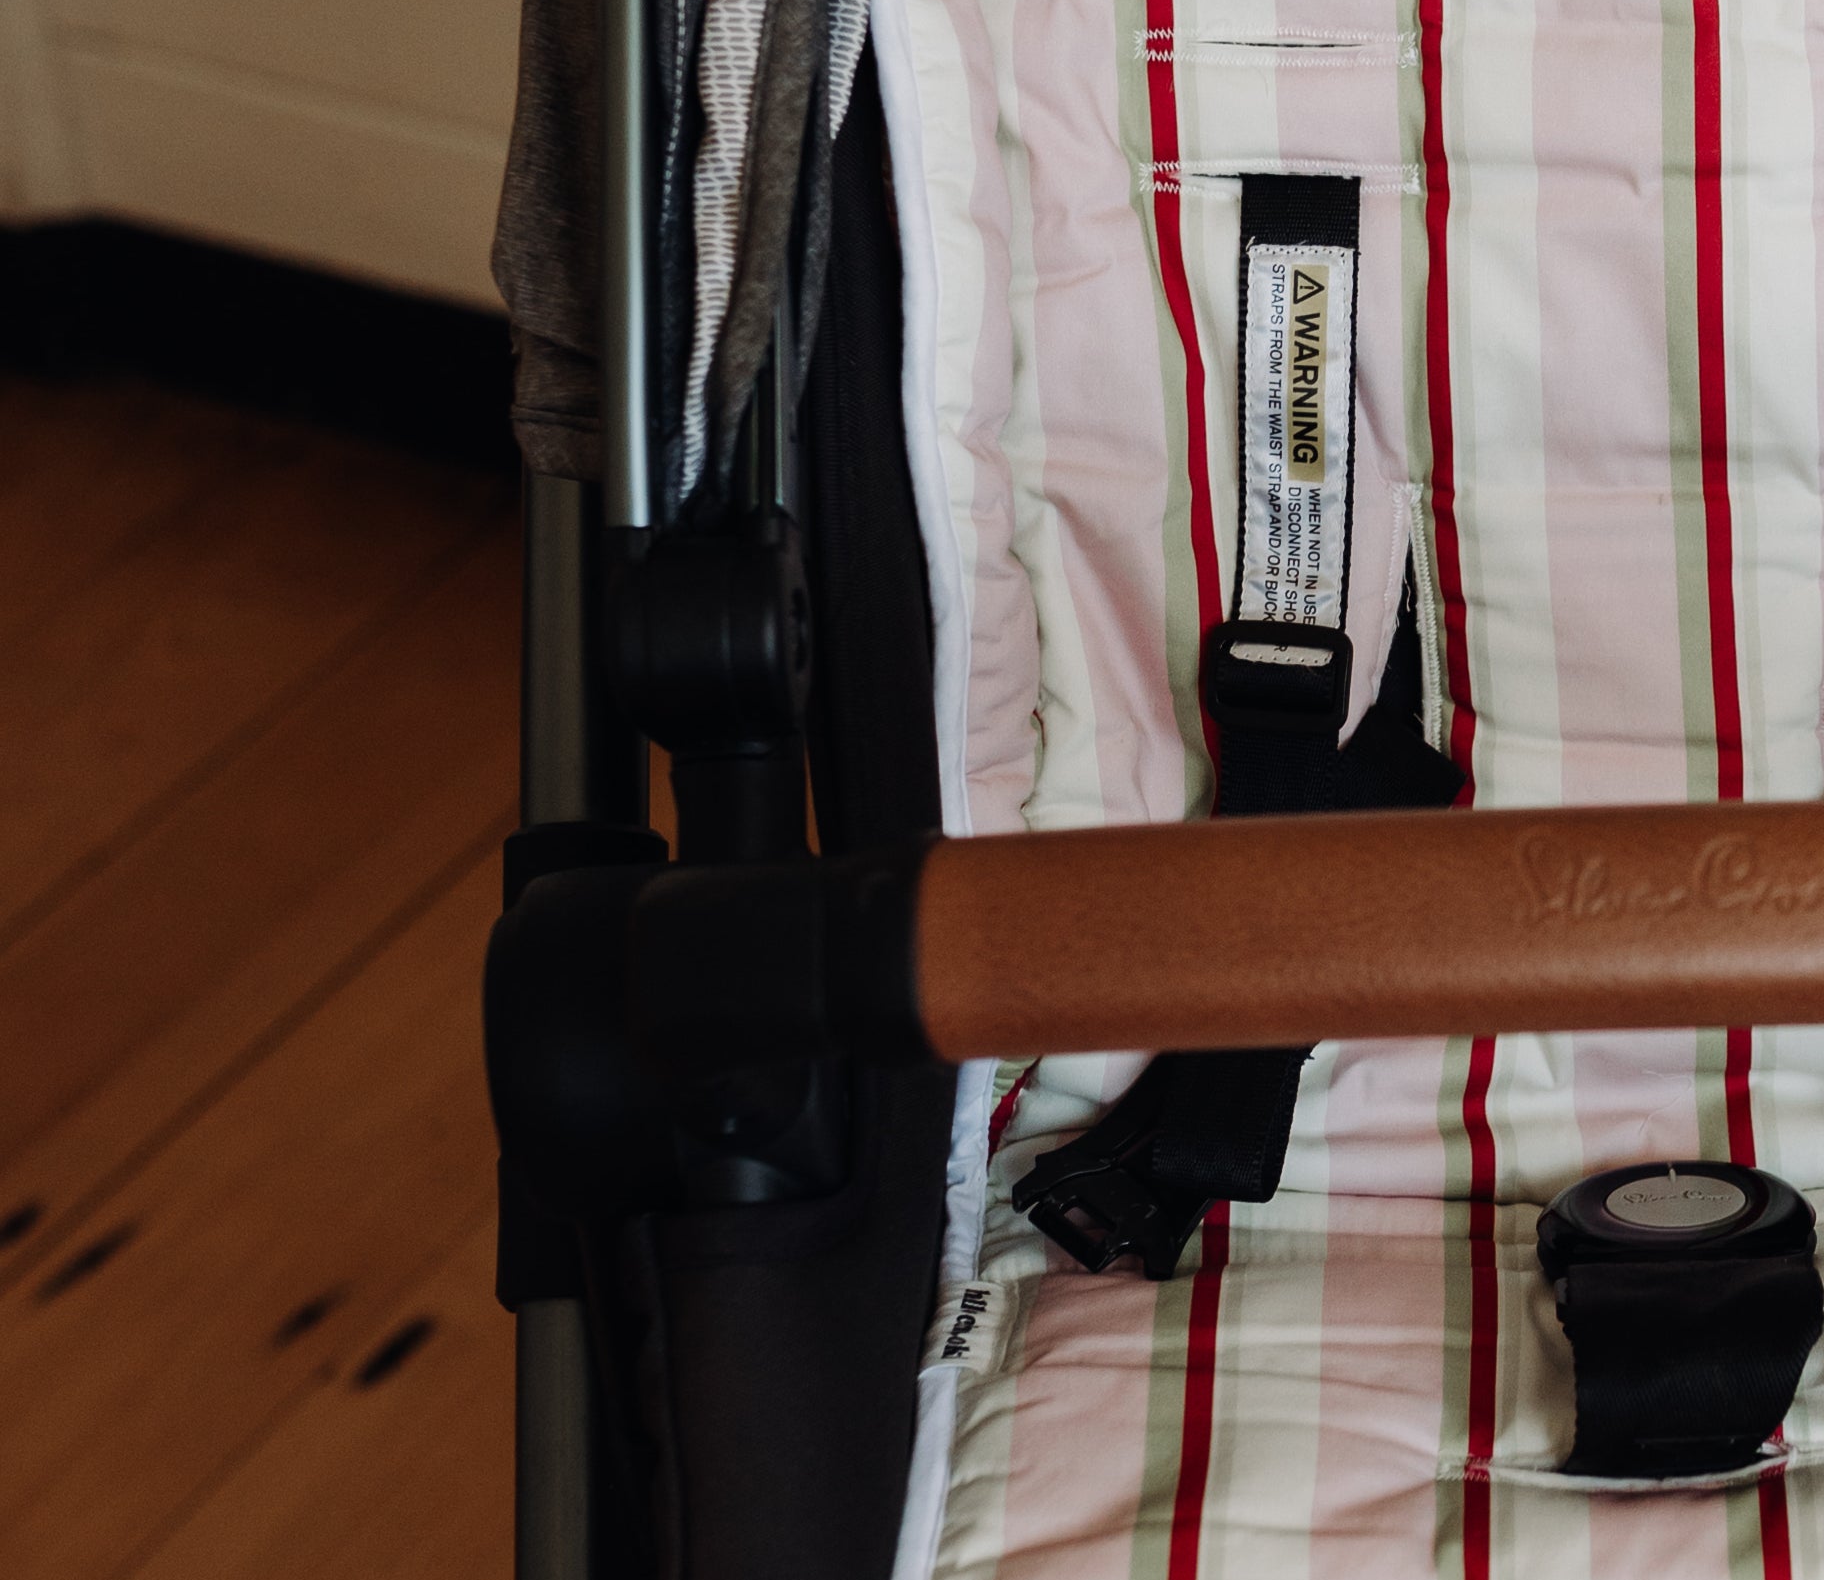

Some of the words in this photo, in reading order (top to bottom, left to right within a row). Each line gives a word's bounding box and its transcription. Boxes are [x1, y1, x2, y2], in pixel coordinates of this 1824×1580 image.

[1270, 263, 1286, 325] STRAPS
[1268, 329, 1283, 374] FROM
[1268, 379, 1282, 410] THE
[1292, 312, 1321, 464] WARNING
[1268, 411, 1283, 460] WAIST
[1268, 463, 1282, 514] STRAP
[1307, 487, 1321, 535] WHEN
[1265, 515, 1282, 577] AND/OR
[1285, 486, 1302, 587] DISCONNECT
[1307, 539, 1321, 572] NOT
[1262, 580, 1279, 622] BUCK
[1304, 574, 1319, 590] IN
[1283, 589, 1298, 623] SHO
[1302, 594, 1317, 626] USE
